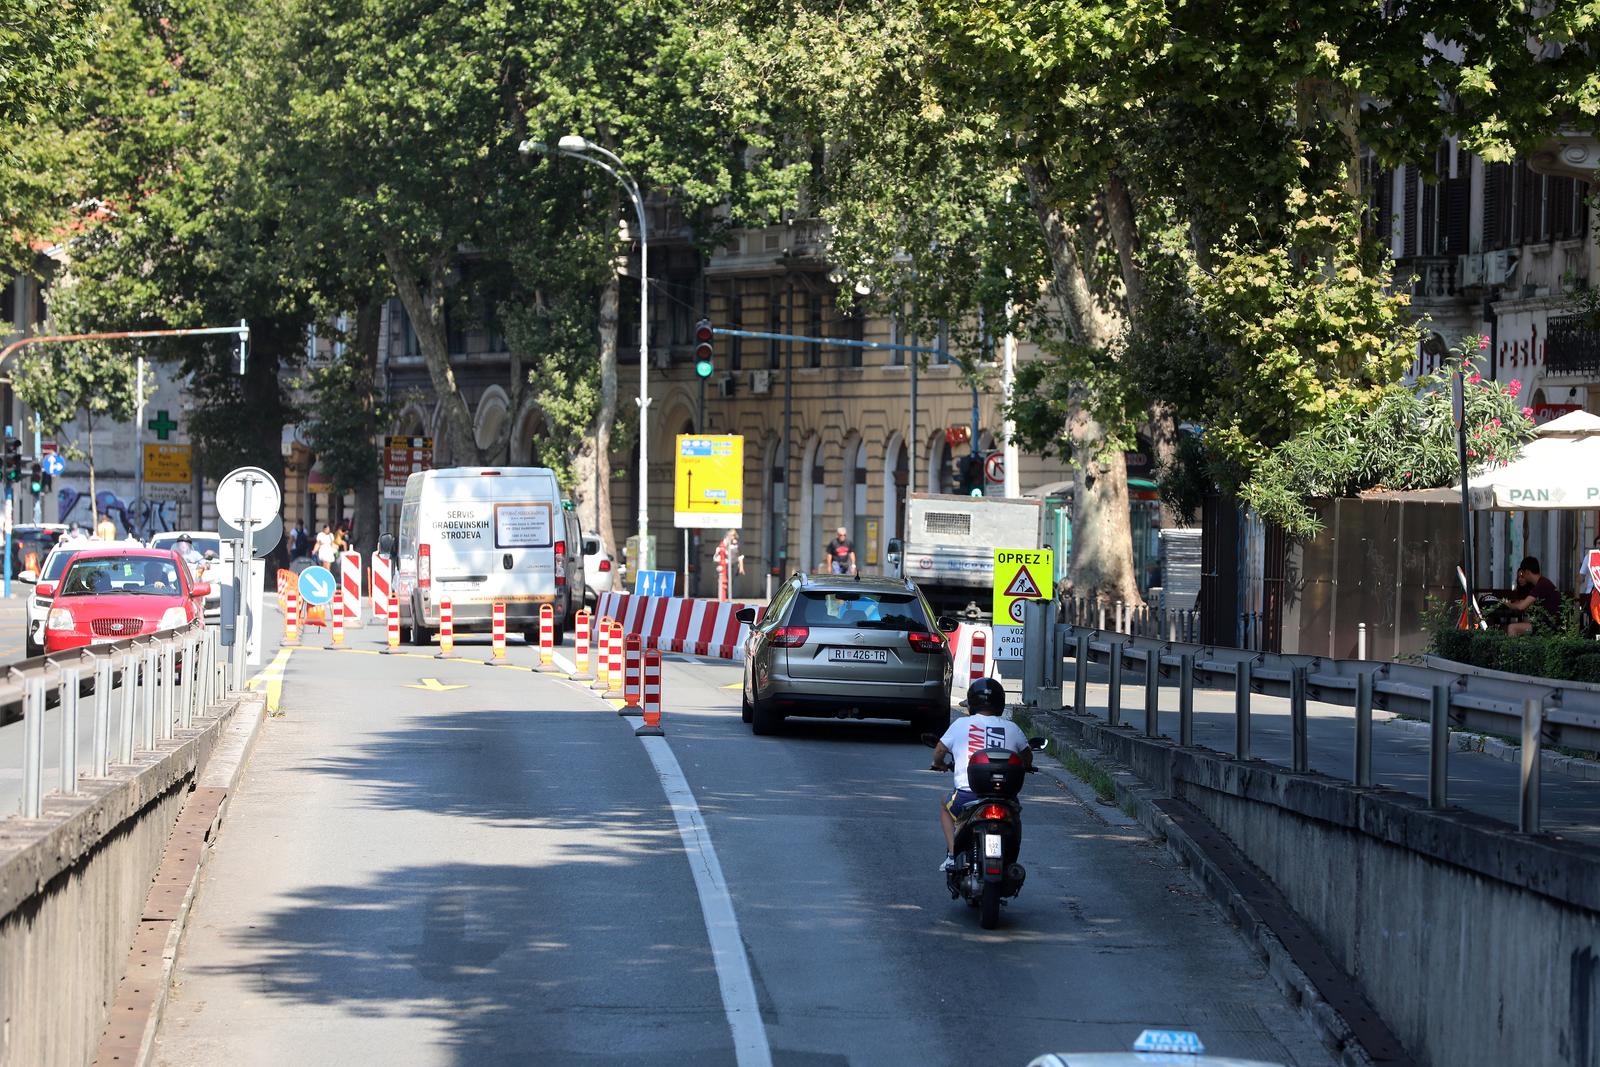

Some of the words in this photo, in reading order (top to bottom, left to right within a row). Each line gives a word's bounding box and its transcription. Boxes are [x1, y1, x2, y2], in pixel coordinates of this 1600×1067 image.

[1509, 488, 1549, 501] PAN
[447, 510, 475, 519] SERVIS
[441, 530, 481, 540] STROJEVA
[998, 552, 1041, 565] OPREZ
[835, 649, 845, 659] RI
[852, 650, 886, 660] 426-TR
[1151, 1032, 1194, 1045] TAXI
